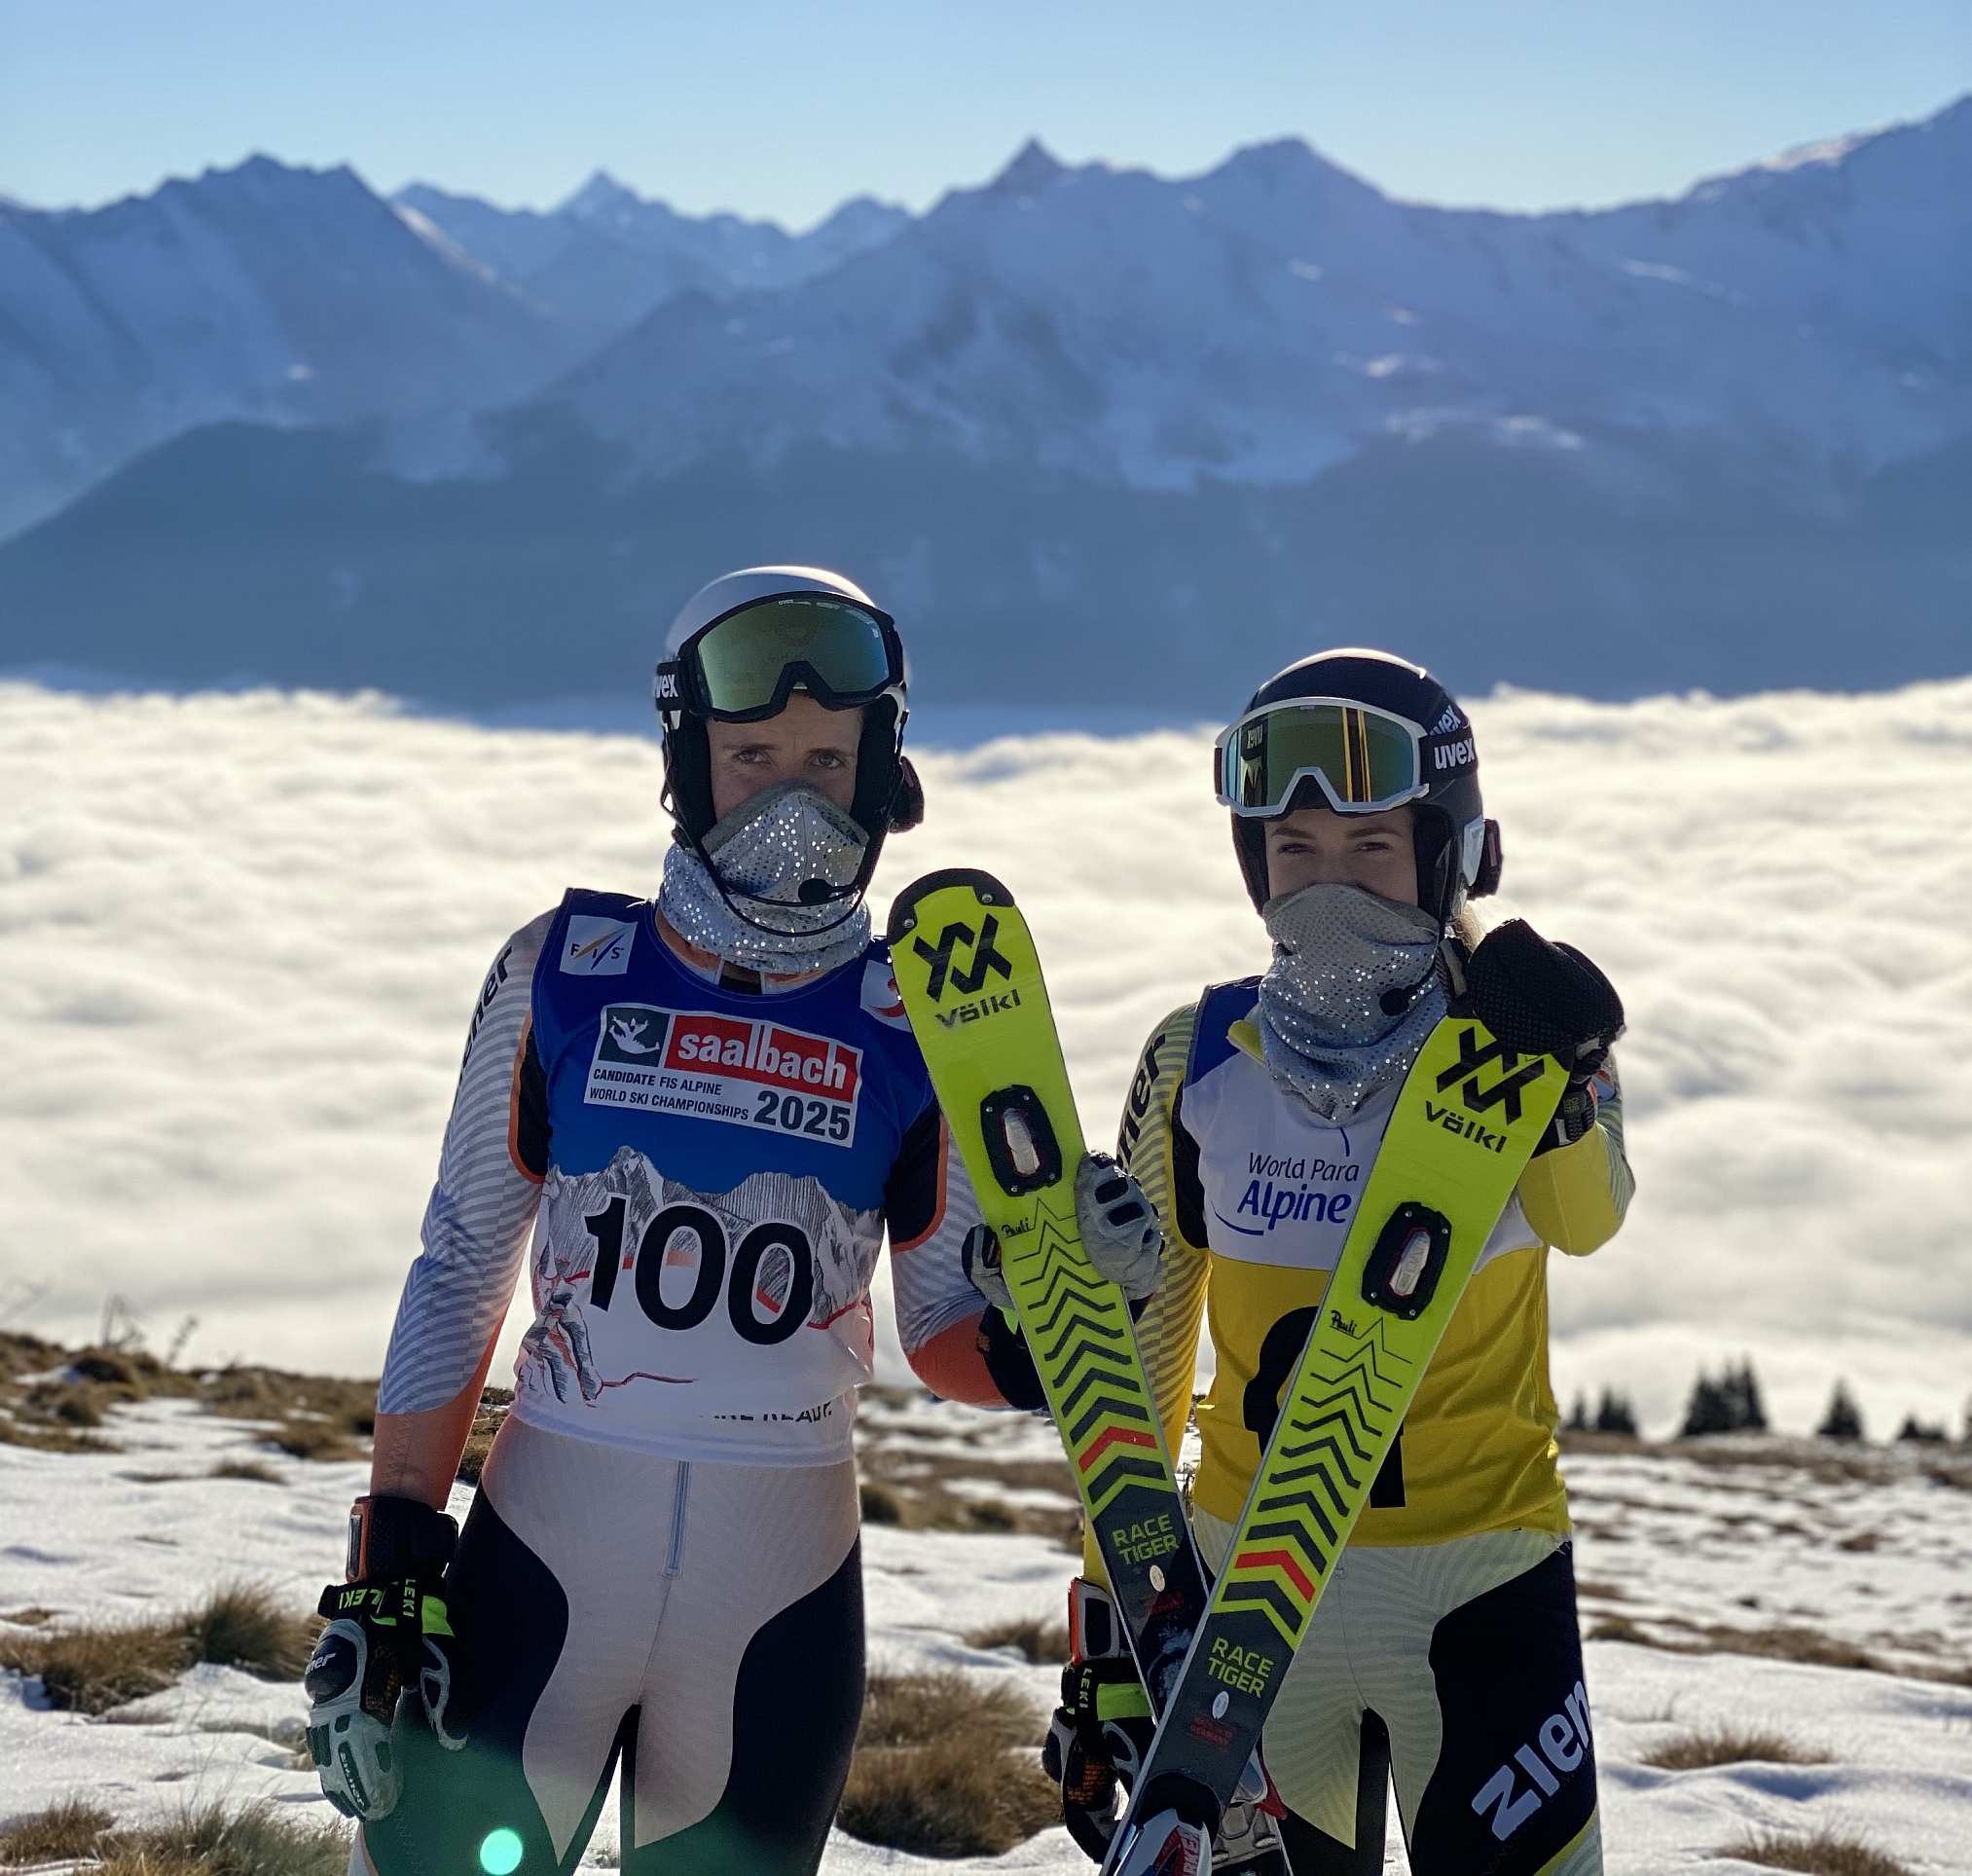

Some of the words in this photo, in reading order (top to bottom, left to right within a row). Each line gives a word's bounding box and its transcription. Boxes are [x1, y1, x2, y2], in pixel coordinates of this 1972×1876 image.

[1434, 738, 1475, 769] uvex
[677, 1022, 848, 1089] saalbach
[593, 1068, 656, 1086] CANDIDATE
[659, 1076, 678, 1089] FIS
[680, 1079, 723, 1096] ALPINE
[589, 1086, 627, 1102] WORLD
[629, 1091, 649, 1105] SKI
[651, 1094, 749, 1121] CHAMPIONSHIPS
[753, 1090, 851, 1141] 2025
[1249, 1152, 1305, 1180] World
[1311, 1159, 1360, 1182] Para
[1237, 1179, 1352, 1231] Alpine
[584, 1193, 814, 1345] 100
[1112, 1514, 1174, 1548] RACE
[1118, 1533, 1180, 1565] TIGER
[338, 1588, 383, 1610] LEKI
[403, 1578, 417, 1618] LEKI
[1212, 1637, 1275, 1678] RACE
[1079, 1667, 1093, 1709] LEKI
[1208, 1657, 1265, 1699] TIGER
